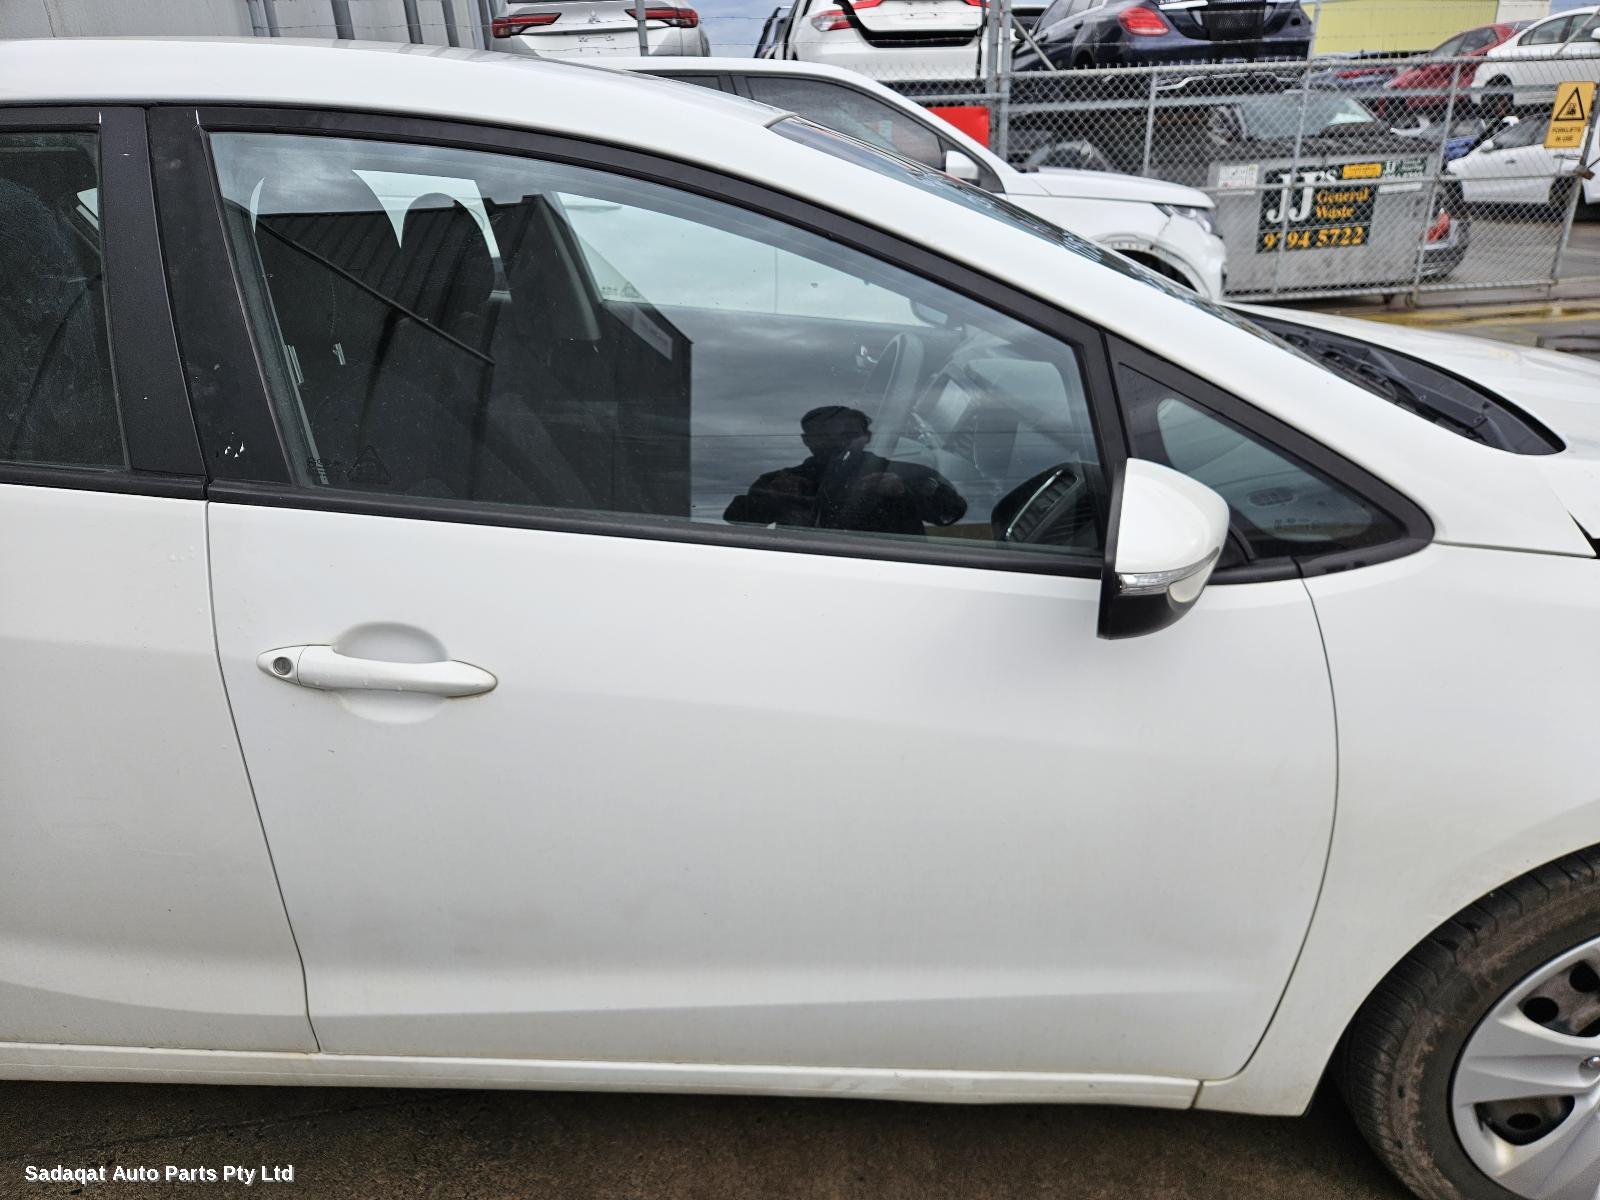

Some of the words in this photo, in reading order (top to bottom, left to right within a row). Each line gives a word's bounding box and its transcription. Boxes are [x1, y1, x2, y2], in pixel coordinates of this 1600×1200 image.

[1316, 187, 1370, 203] General
[1316, 204, 1355, 219] Waste
[1316, 225, 1364, 247] 5722
